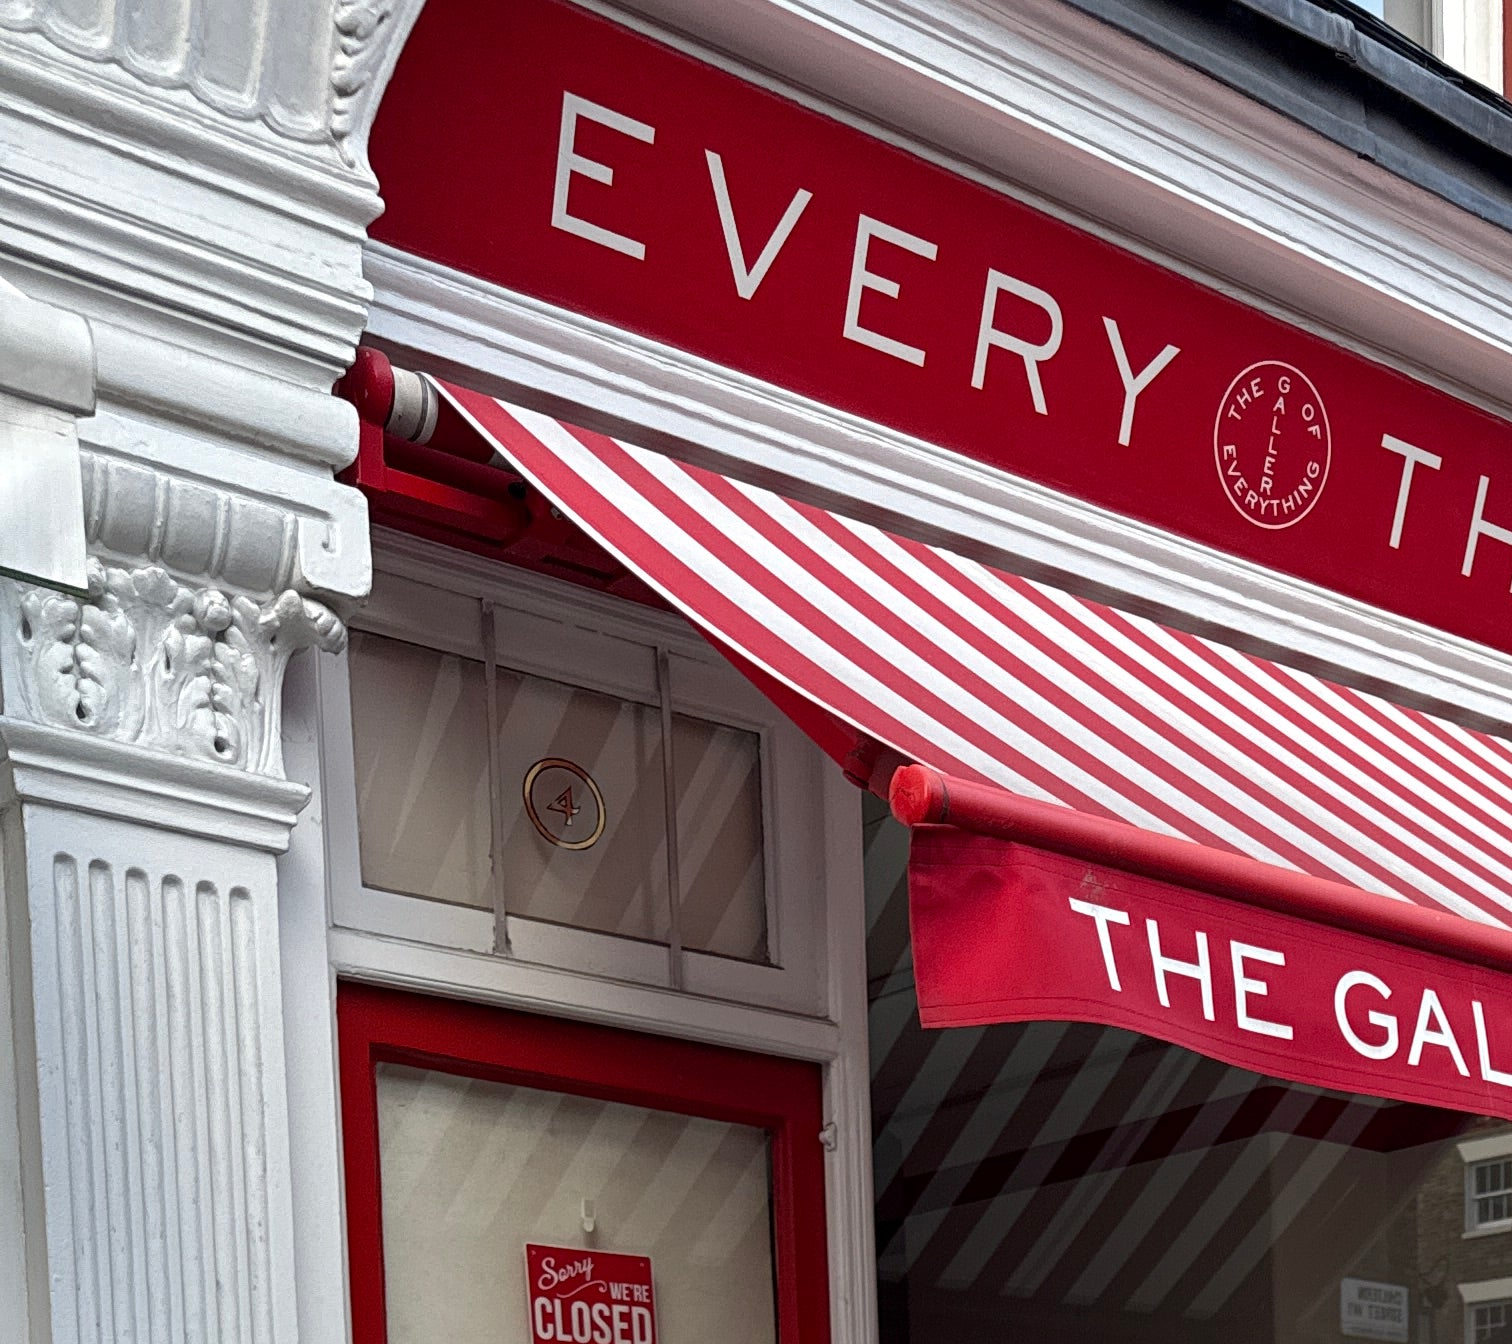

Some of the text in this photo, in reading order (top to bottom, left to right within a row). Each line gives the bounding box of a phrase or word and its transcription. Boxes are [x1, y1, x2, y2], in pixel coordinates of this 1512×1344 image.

[551, 90, 1181, 447] EVERY
[1228, 377, 1264, 420] THE
[1301, 404, 1321, 439] OF
[1223, 445, 1320, 516] EVERYTHING
[546, 785, 581, 826] 4
[1068, 896, 1294, 1041] THE
[538, 1257, 594, 1290] Sorry
[609, 1281, 651, 1303] WE'RE
